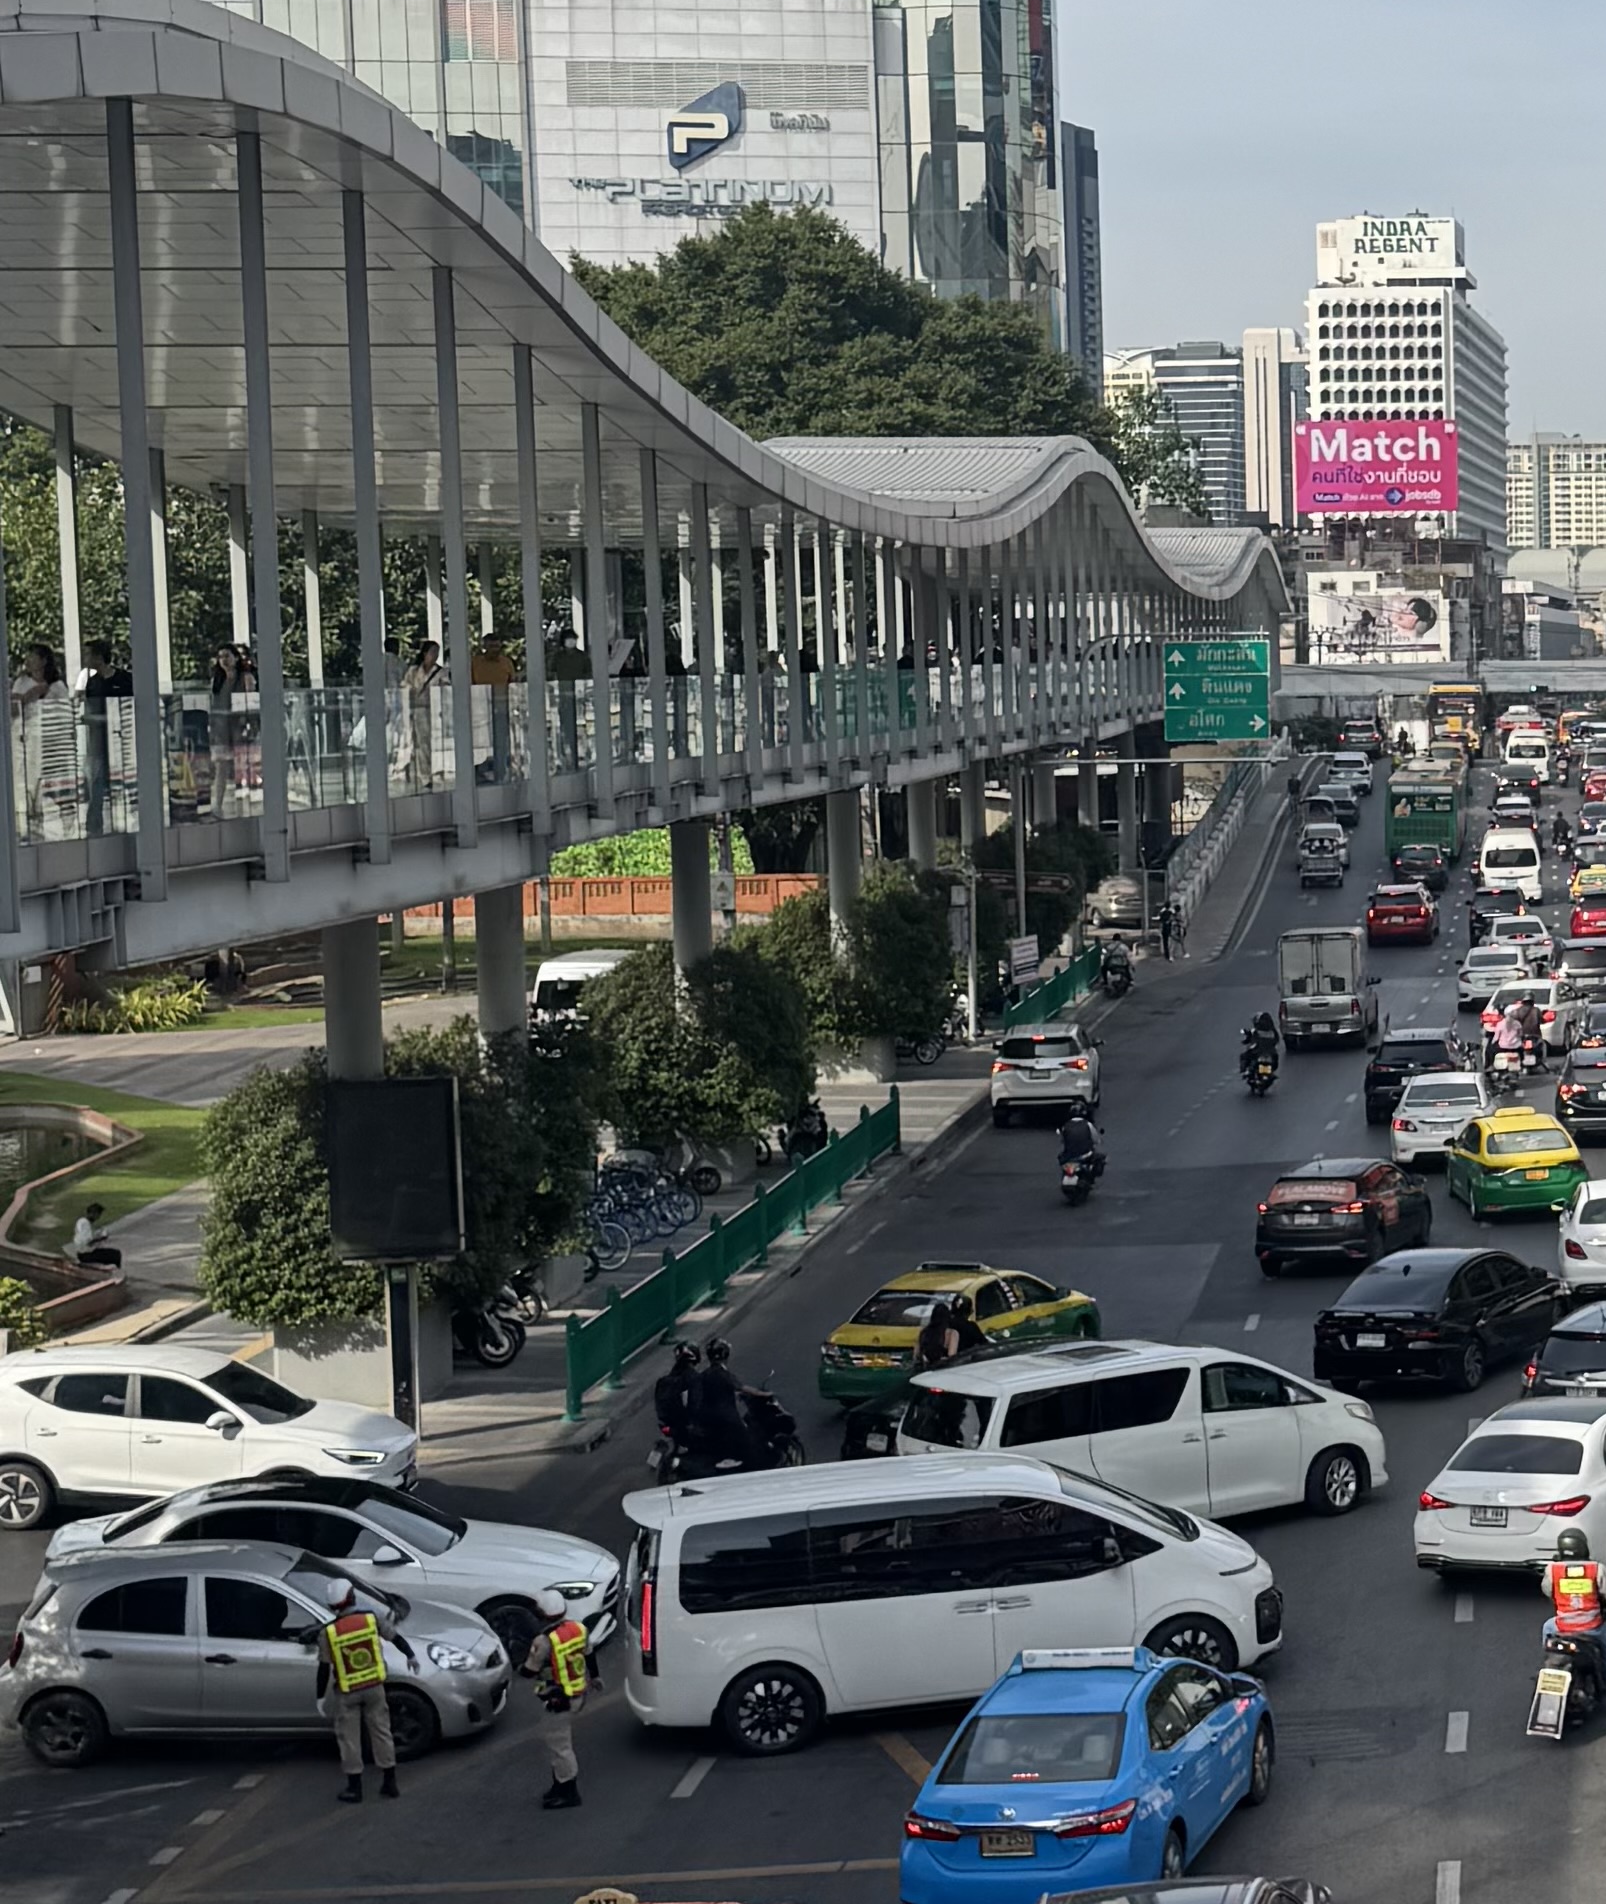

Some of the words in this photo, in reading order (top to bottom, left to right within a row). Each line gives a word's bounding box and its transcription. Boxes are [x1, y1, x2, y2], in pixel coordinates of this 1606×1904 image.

[1363, 220, 1428, 237] INDRA
[1354, 237, 1439, 254] REGENT
[1310, 426, 1442, 462] Match
